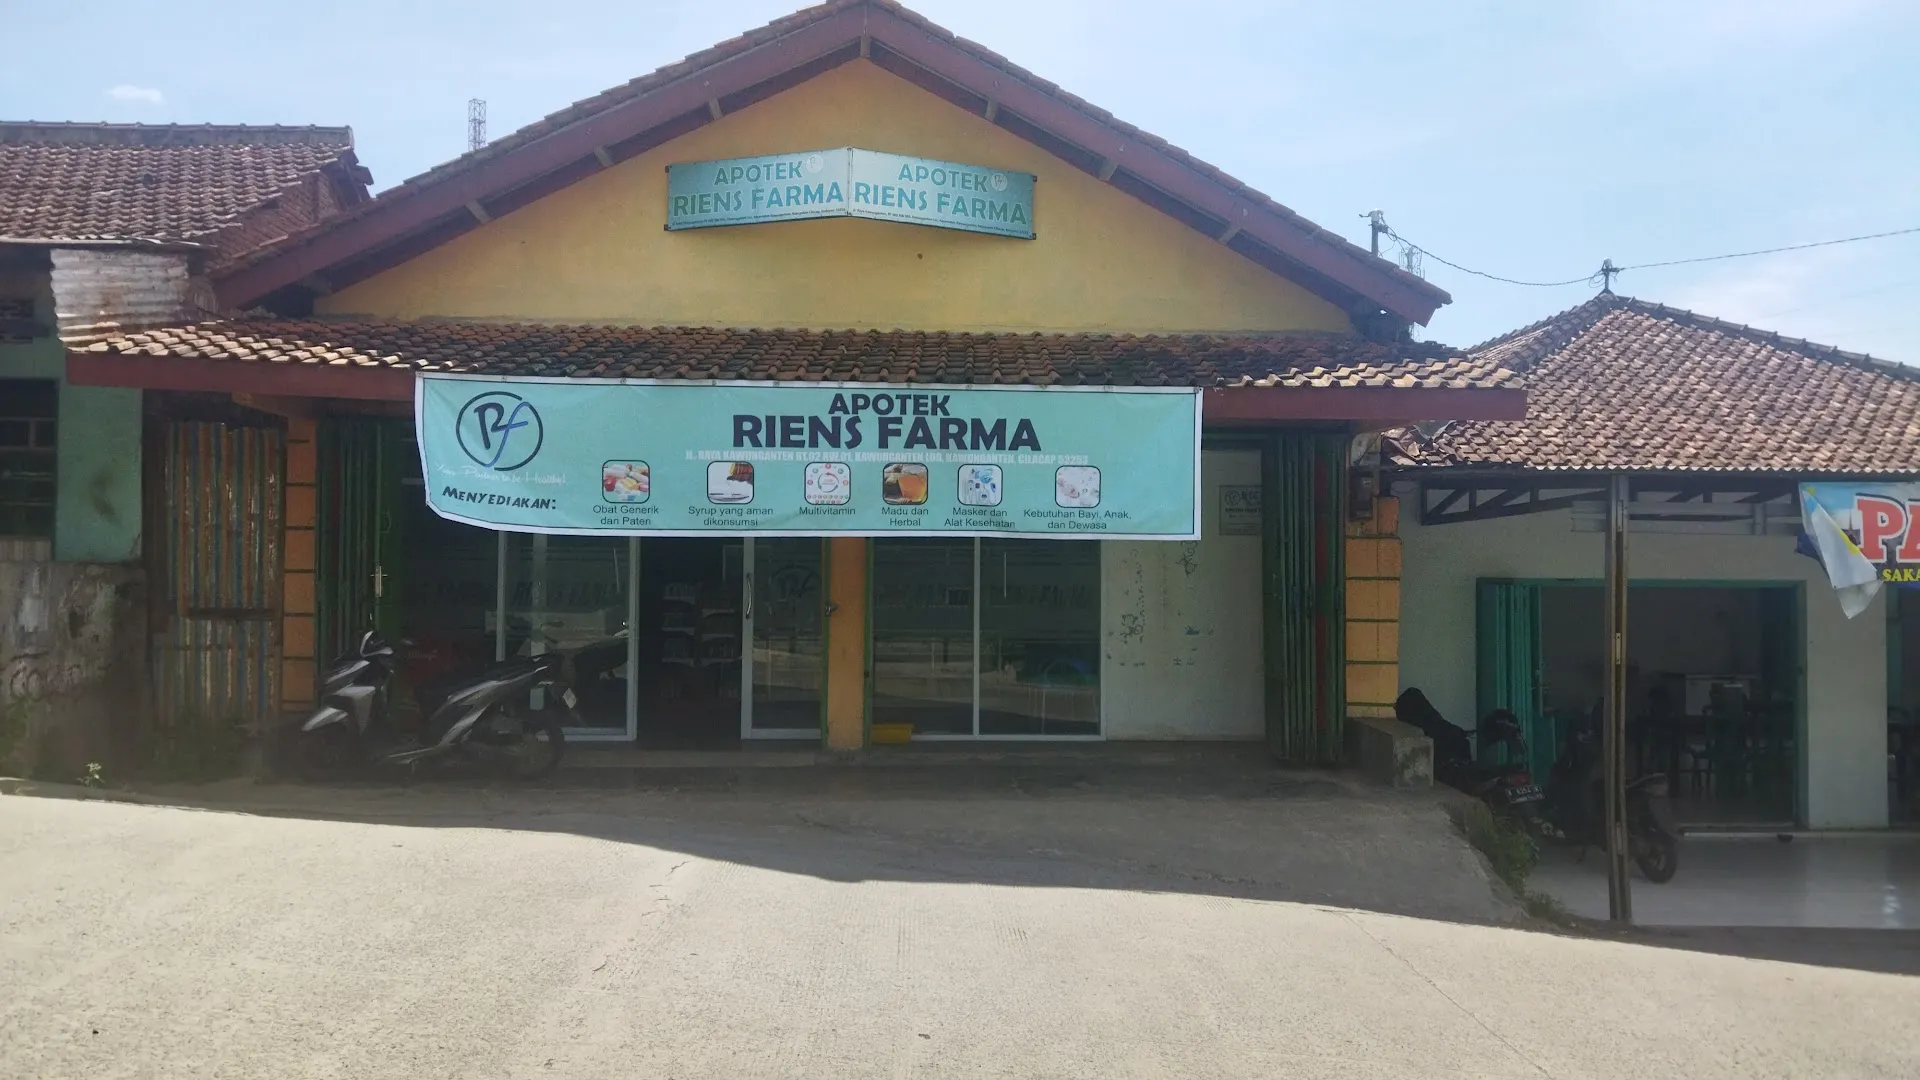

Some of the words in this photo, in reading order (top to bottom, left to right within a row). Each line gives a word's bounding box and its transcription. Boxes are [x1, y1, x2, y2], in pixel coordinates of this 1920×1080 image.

[714, 160, 803, 186] APOTEK
[898, 163, 989, 193] APOTEK
[673, 189, 743, 217] RIENS
[751, 181, 845, 209] FARMA
[854, 182, 928, 211] RIENS
[937, 192, 1027, 225] FARMA
[828, 393, 951, 417] APOTEK
[732, 414, 862, 450] RIENS
[878, 417, 1041, 451] FARMA
[698, 451, 721, 460] RAYA
[722, 451, 794, 461] KAWUNGANTEN
[855, 452, 923, 462] KAWUNGANTEN
[1018, 454, 1056, 464] CILACAP
[592, 505, 618, 514] Obat
[620, 505, 659, 514] Generik
[688, 506, 715, 517] Syrup
[717, 508, 742, 518] yang
[746, 508, 774, 516] aman
[799, 506, 856, 516] Multivitamin
[881, 507, 907, 516] Madu
[909, 507, 929, 516] dan
[952, 507, 987, 516] Masker
[988, 508, 1008, 517] dan
[1023, 509, 1075, 519] Kebutuhan
[1078, 510, 1102, 521] Bayi,
[1105, 511, 1132, 521] Anak,
[600, 516, 620, 526] dan
[622, 516, 651, 526] Paten
[703, 516, 759, 526] dikonsumsi
[889, 517, 921, 527] Herbal
[944, 518, 963, 528] Alat
[965, 518, 1016, 529] Kesehatan
[1048, 520, 1067, 530] dan
[1069, 520, 1107, 530] Dewasa
